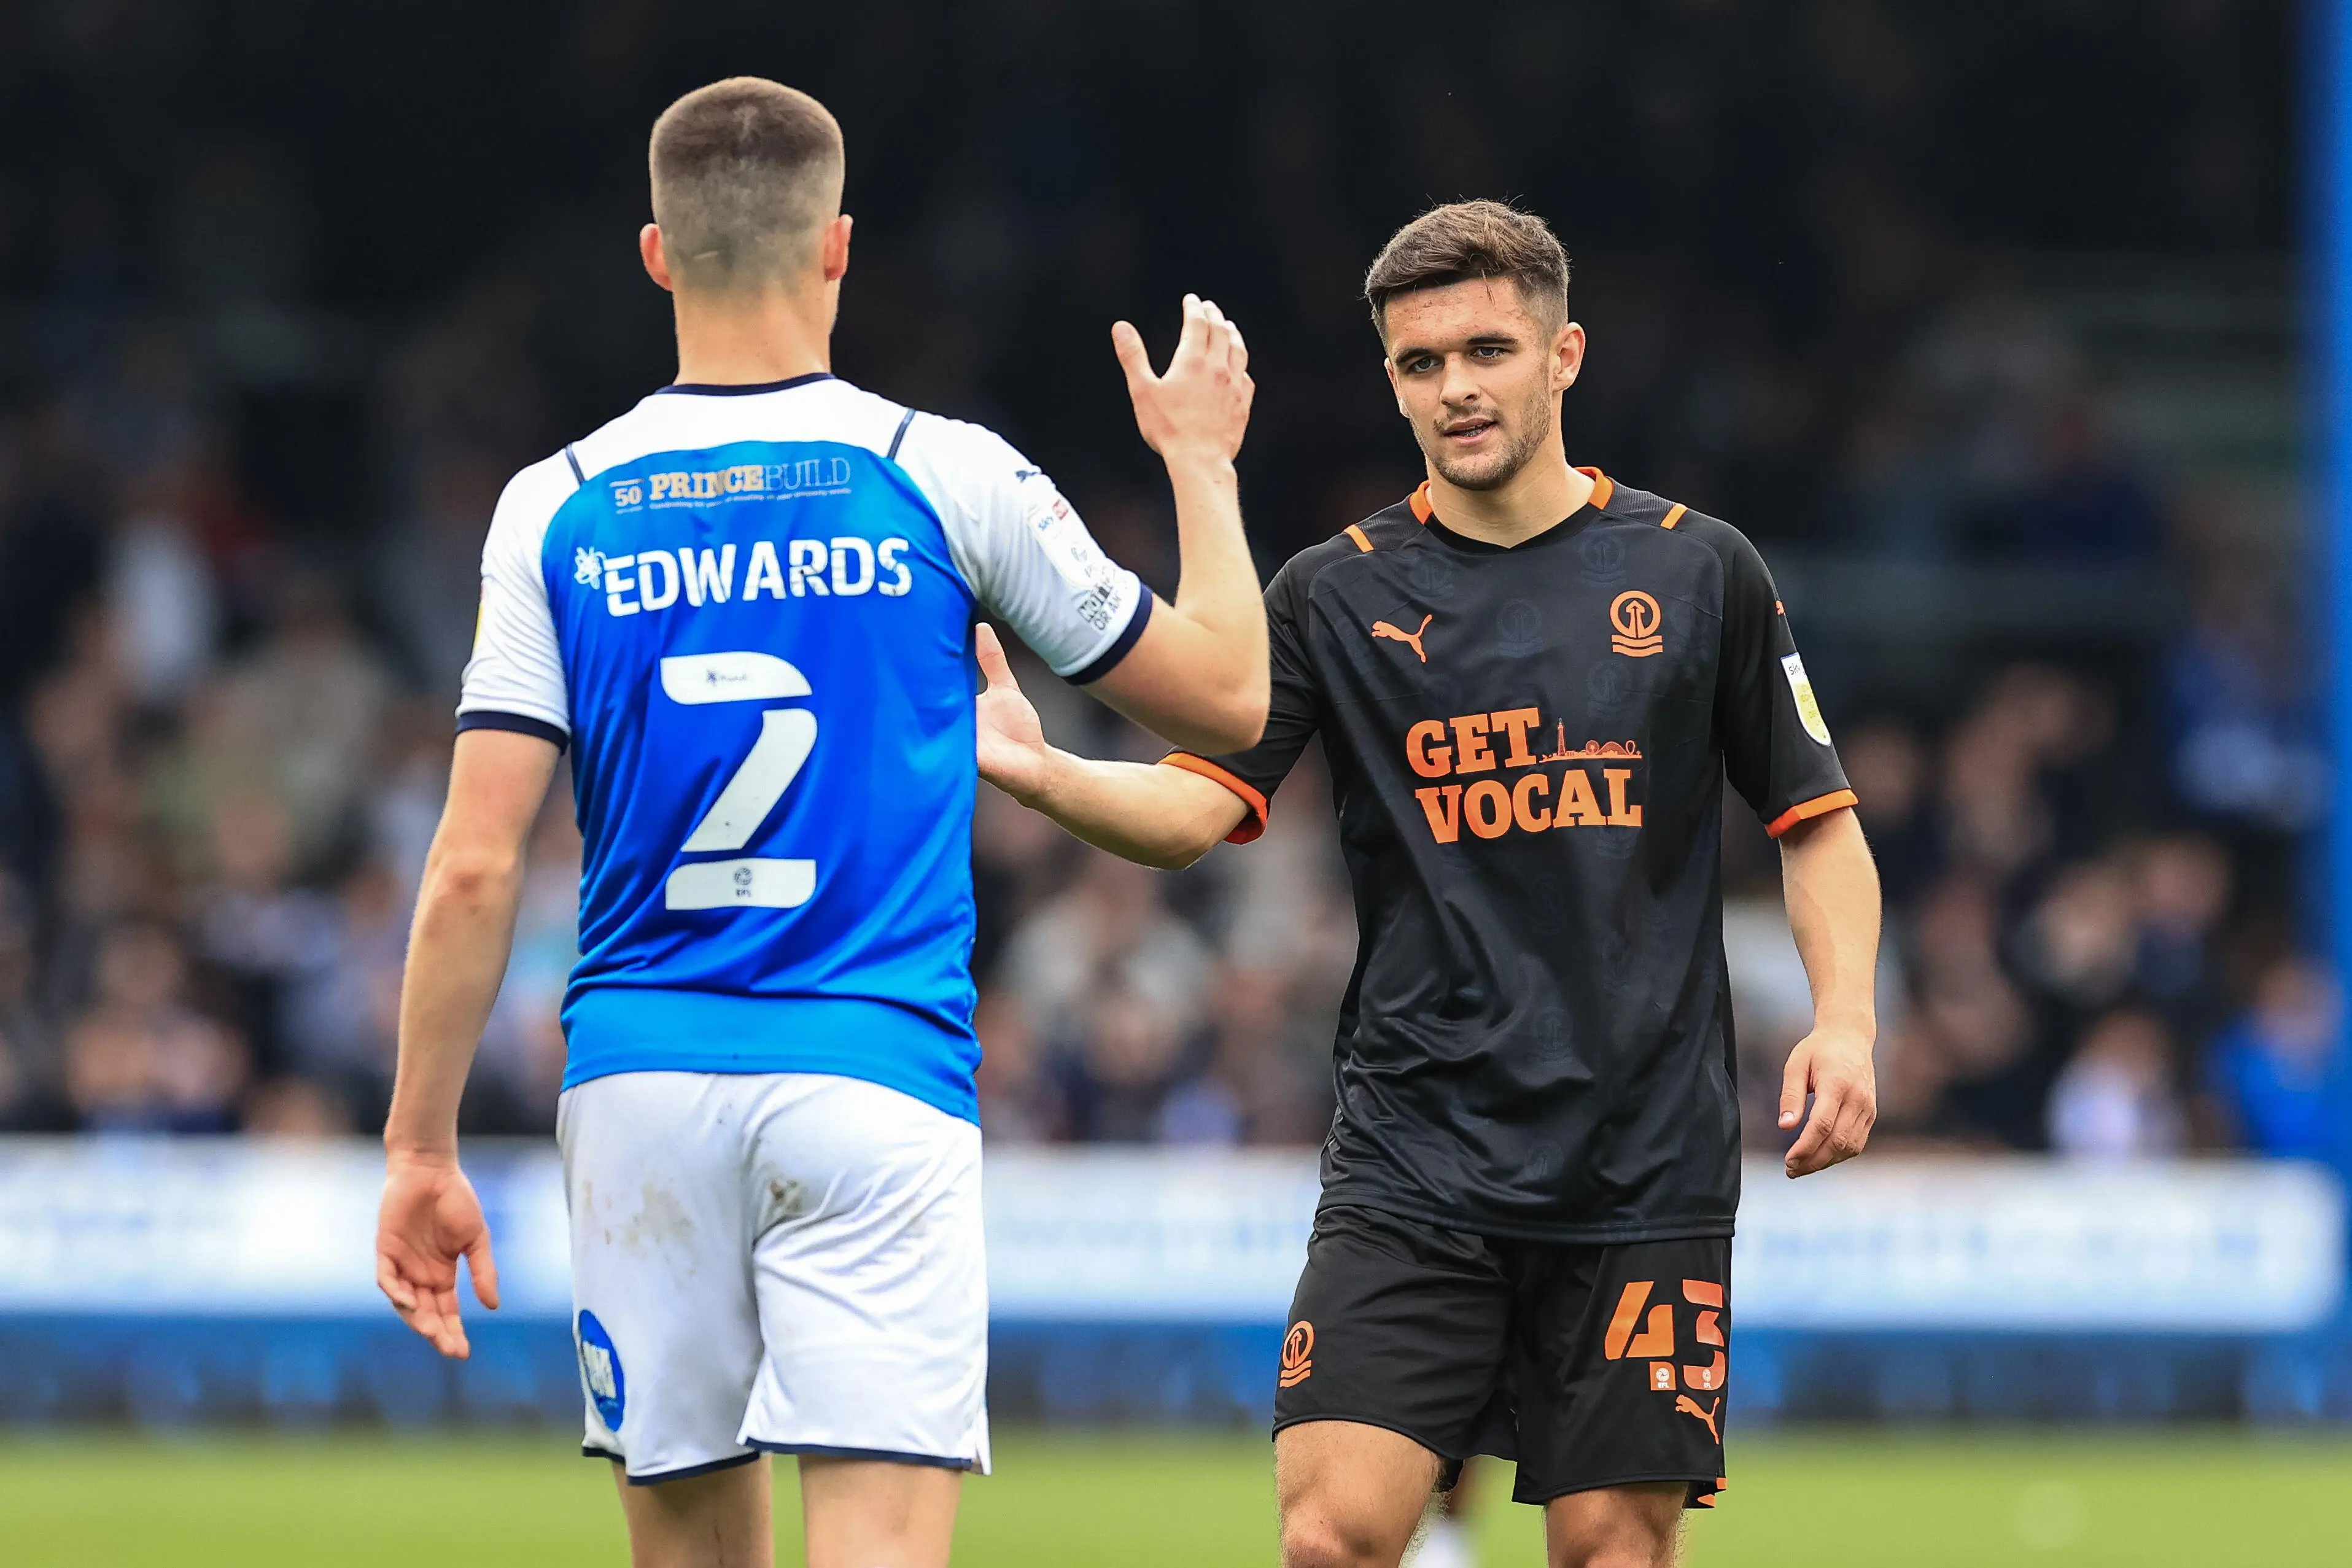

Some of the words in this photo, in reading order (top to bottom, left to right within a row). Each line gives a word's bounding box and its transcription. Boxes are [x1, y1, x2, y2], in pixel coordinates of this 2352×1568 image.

[615, 486, 642, 506] 50
[648, 457, 851, 500] PRINCEBUILD
[604, 537, 912, 616] EDWARDS
[660, 651, 818, 910] 2
[1407, 707, 1540, 777] GET
[1415, 769, 1642, 844] VOCAL
[1605, 1279, 1726, 1390] 43
